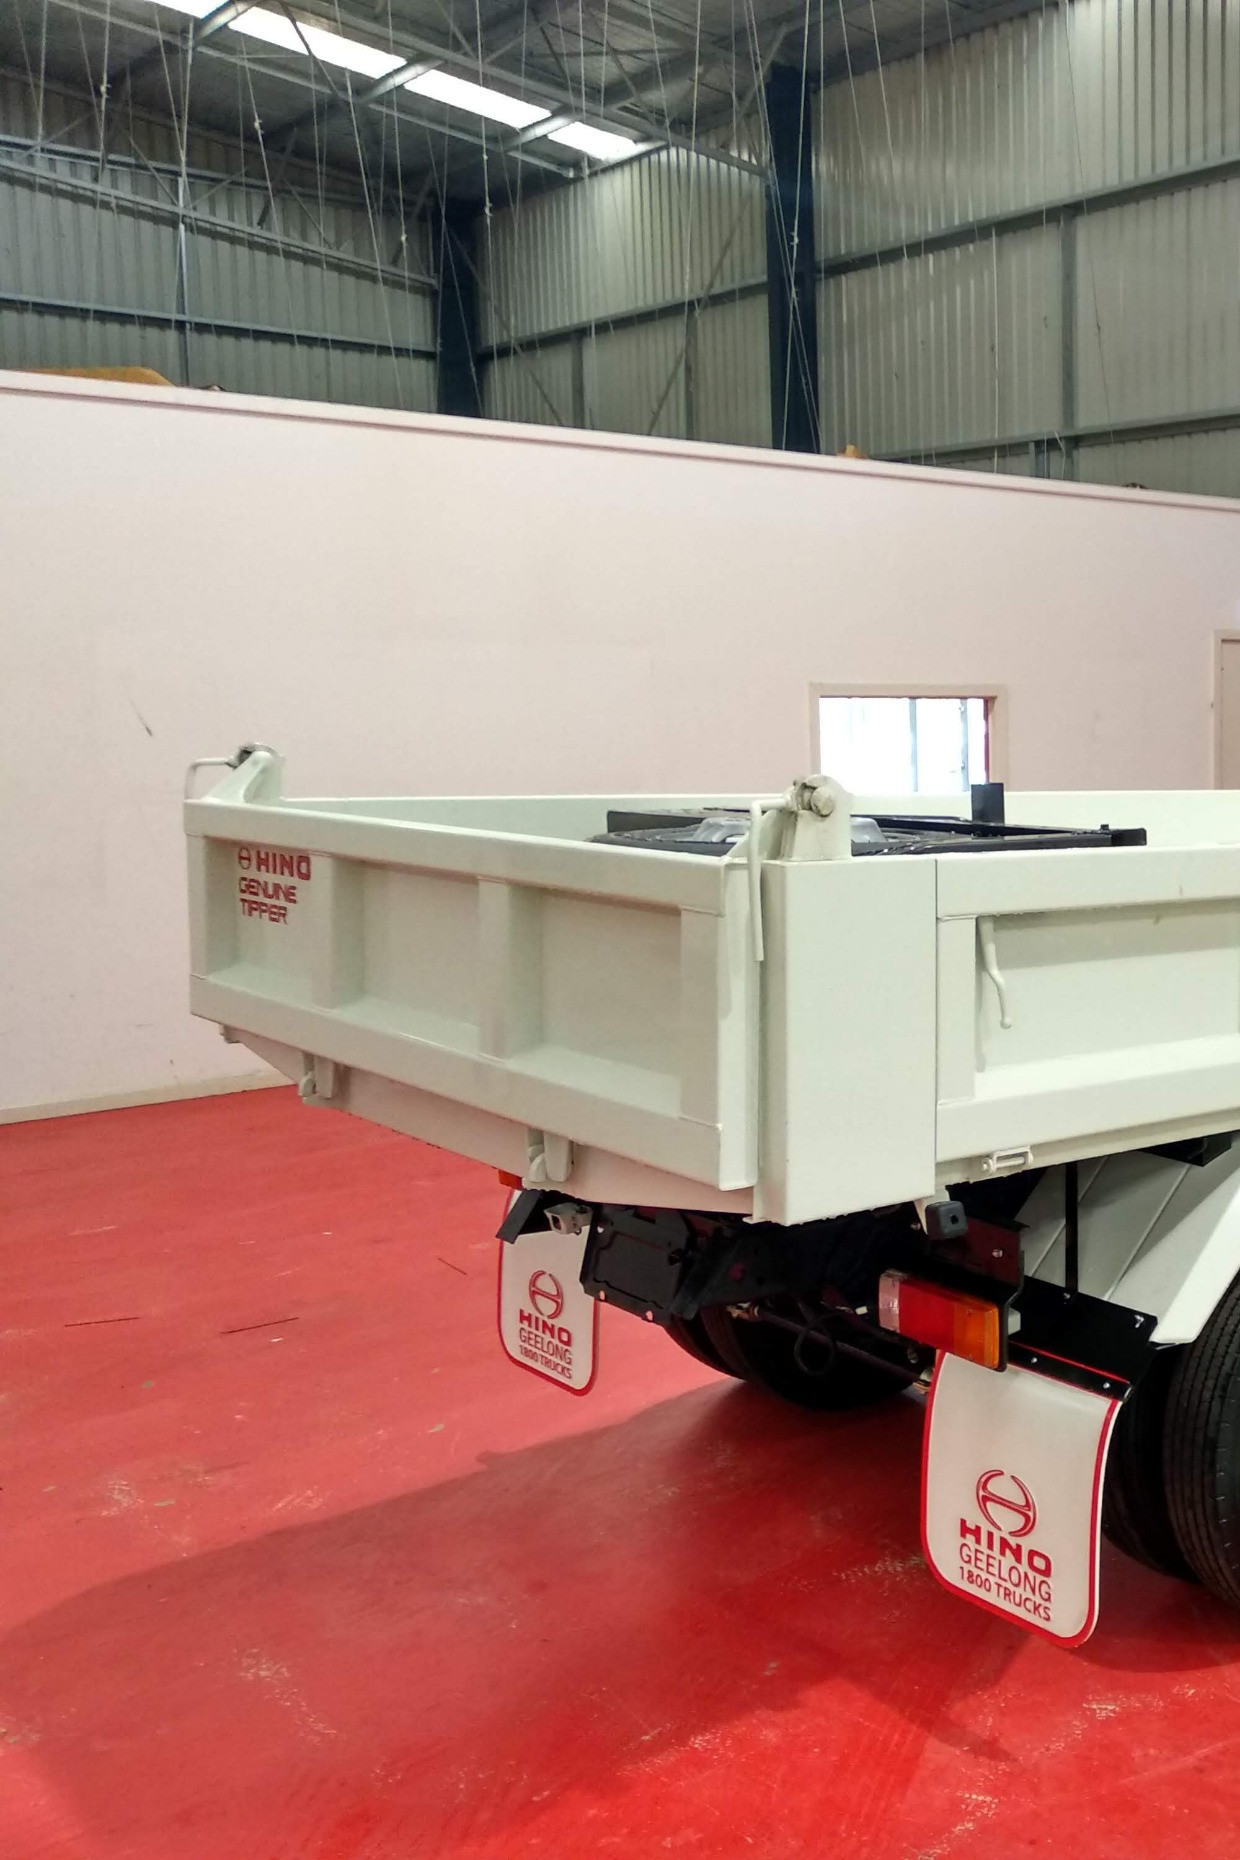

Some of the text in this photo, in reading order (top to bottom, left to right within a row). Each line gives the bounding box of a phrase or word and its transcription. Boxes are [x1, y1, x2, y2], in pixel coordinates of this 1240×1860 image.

[256, 850, 310, 880] HINO
[519, 1308, 572, 1347] HINO
[519, 1327, 572, 1366] GEELONG
[519, 1345, 572, 1380] 1800 TRUCKS
[959, 1518, 1052, 1578] HINO
[959, 1542, 1052, 1603] GEELONG
[959, 1566, 1052, 1623] 1800 TRUCKS
